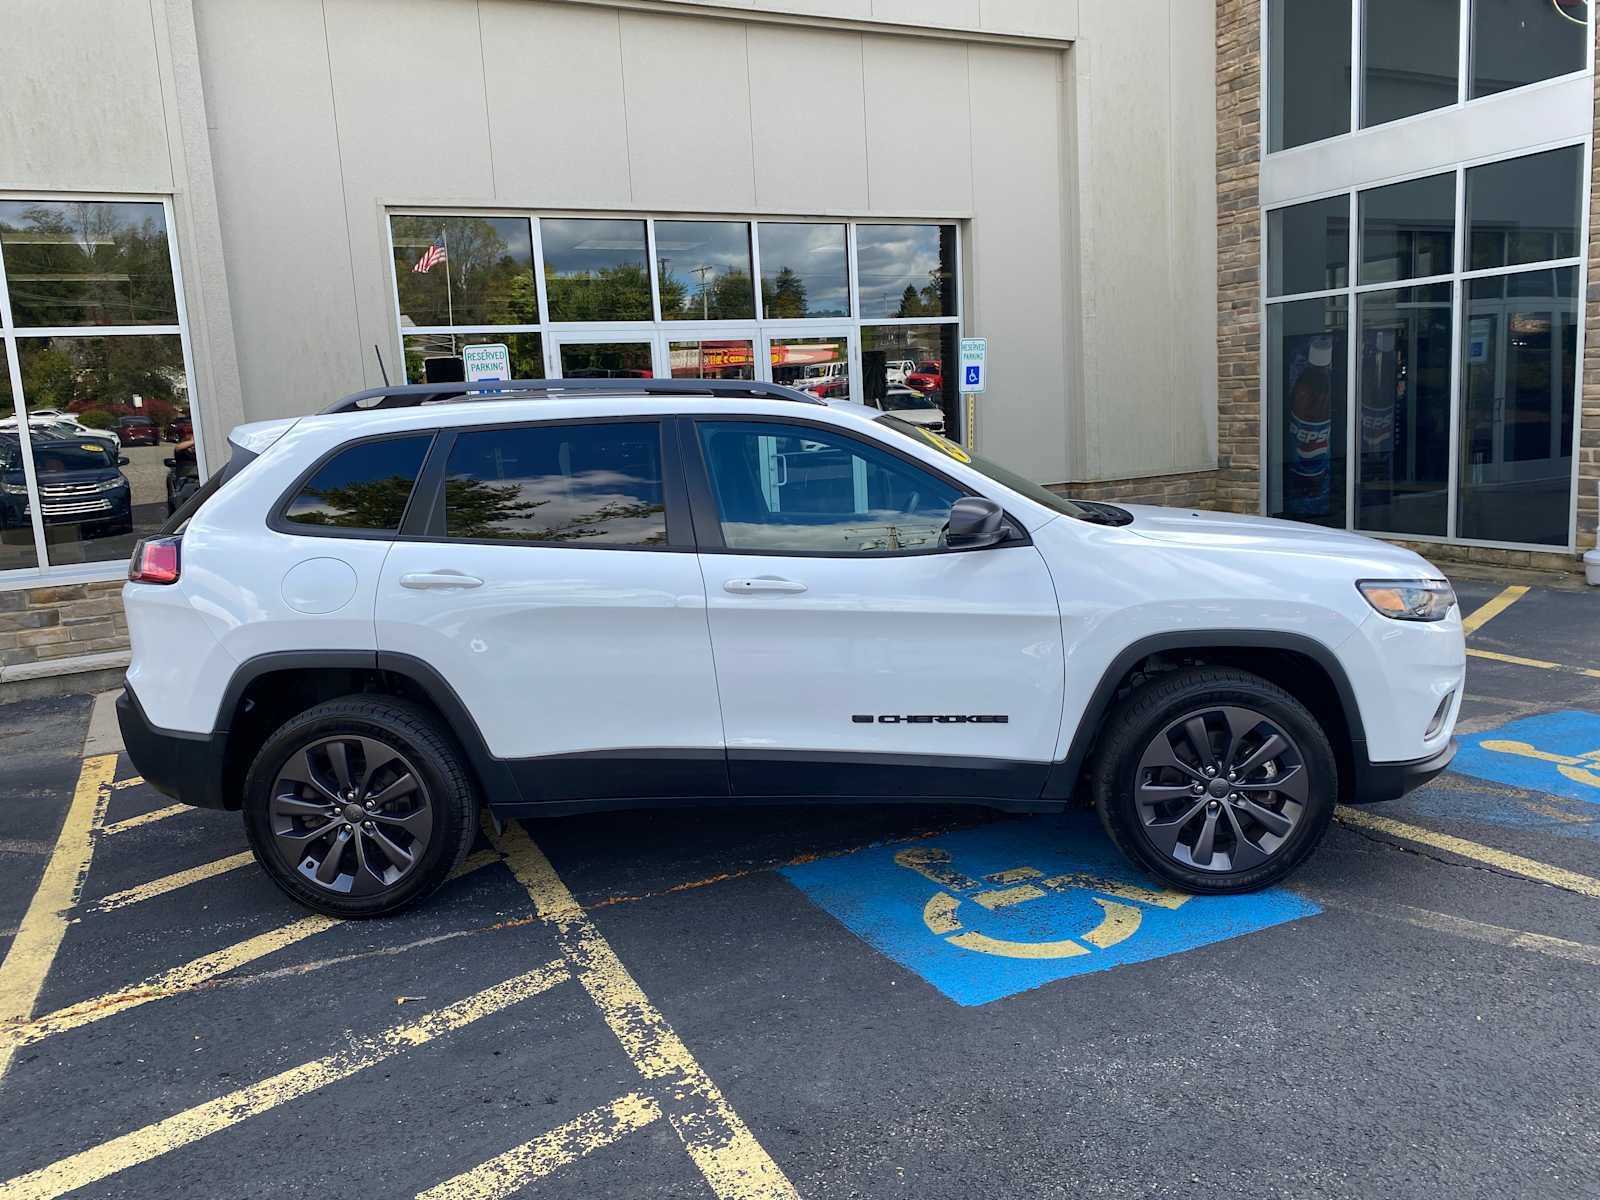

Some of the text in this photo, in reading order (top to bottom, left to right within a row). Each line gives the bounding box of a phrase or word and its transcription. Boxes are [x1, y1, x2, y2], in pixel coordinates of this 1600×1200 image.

[961, 343, 985, 351] RESERVED
[467, 351, 505, 361] RESERVED
[963, 352, 984, 360] PARKING
[470, 362, 504, 372] PARKING
[877, 714, 1009, 724] CHEROKEE
